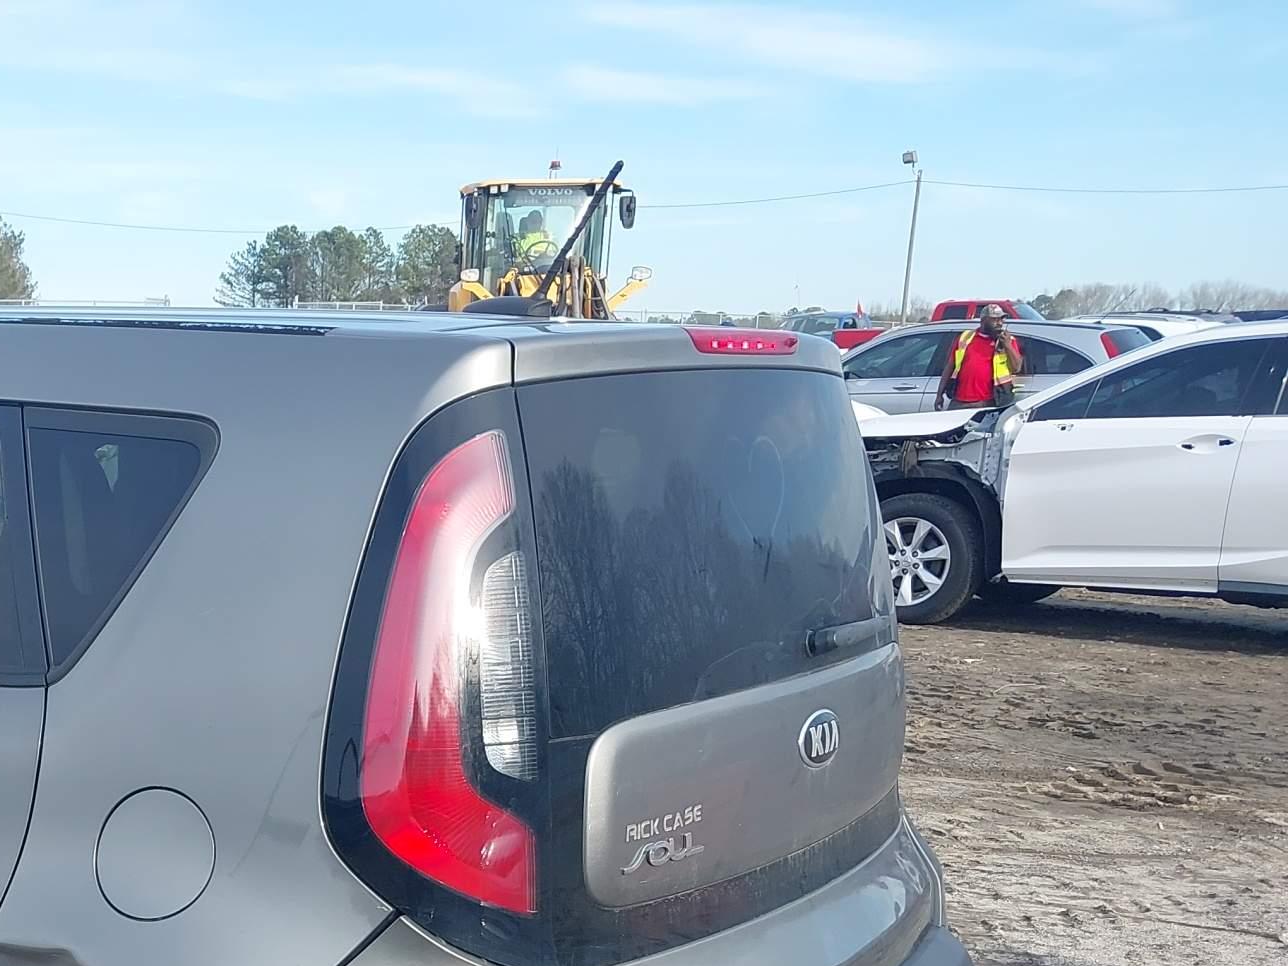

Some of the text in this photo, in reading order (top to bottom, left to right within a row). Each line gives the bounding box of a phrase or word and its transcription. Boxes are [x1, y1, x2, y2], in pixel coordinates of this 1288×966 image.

[528, 188, 573, 196] VOLVO
[810, 720, 839, 757] KIA
[626, 804, 702, 842] RICK CASE
[620, 832, 704, 875] SOUL
